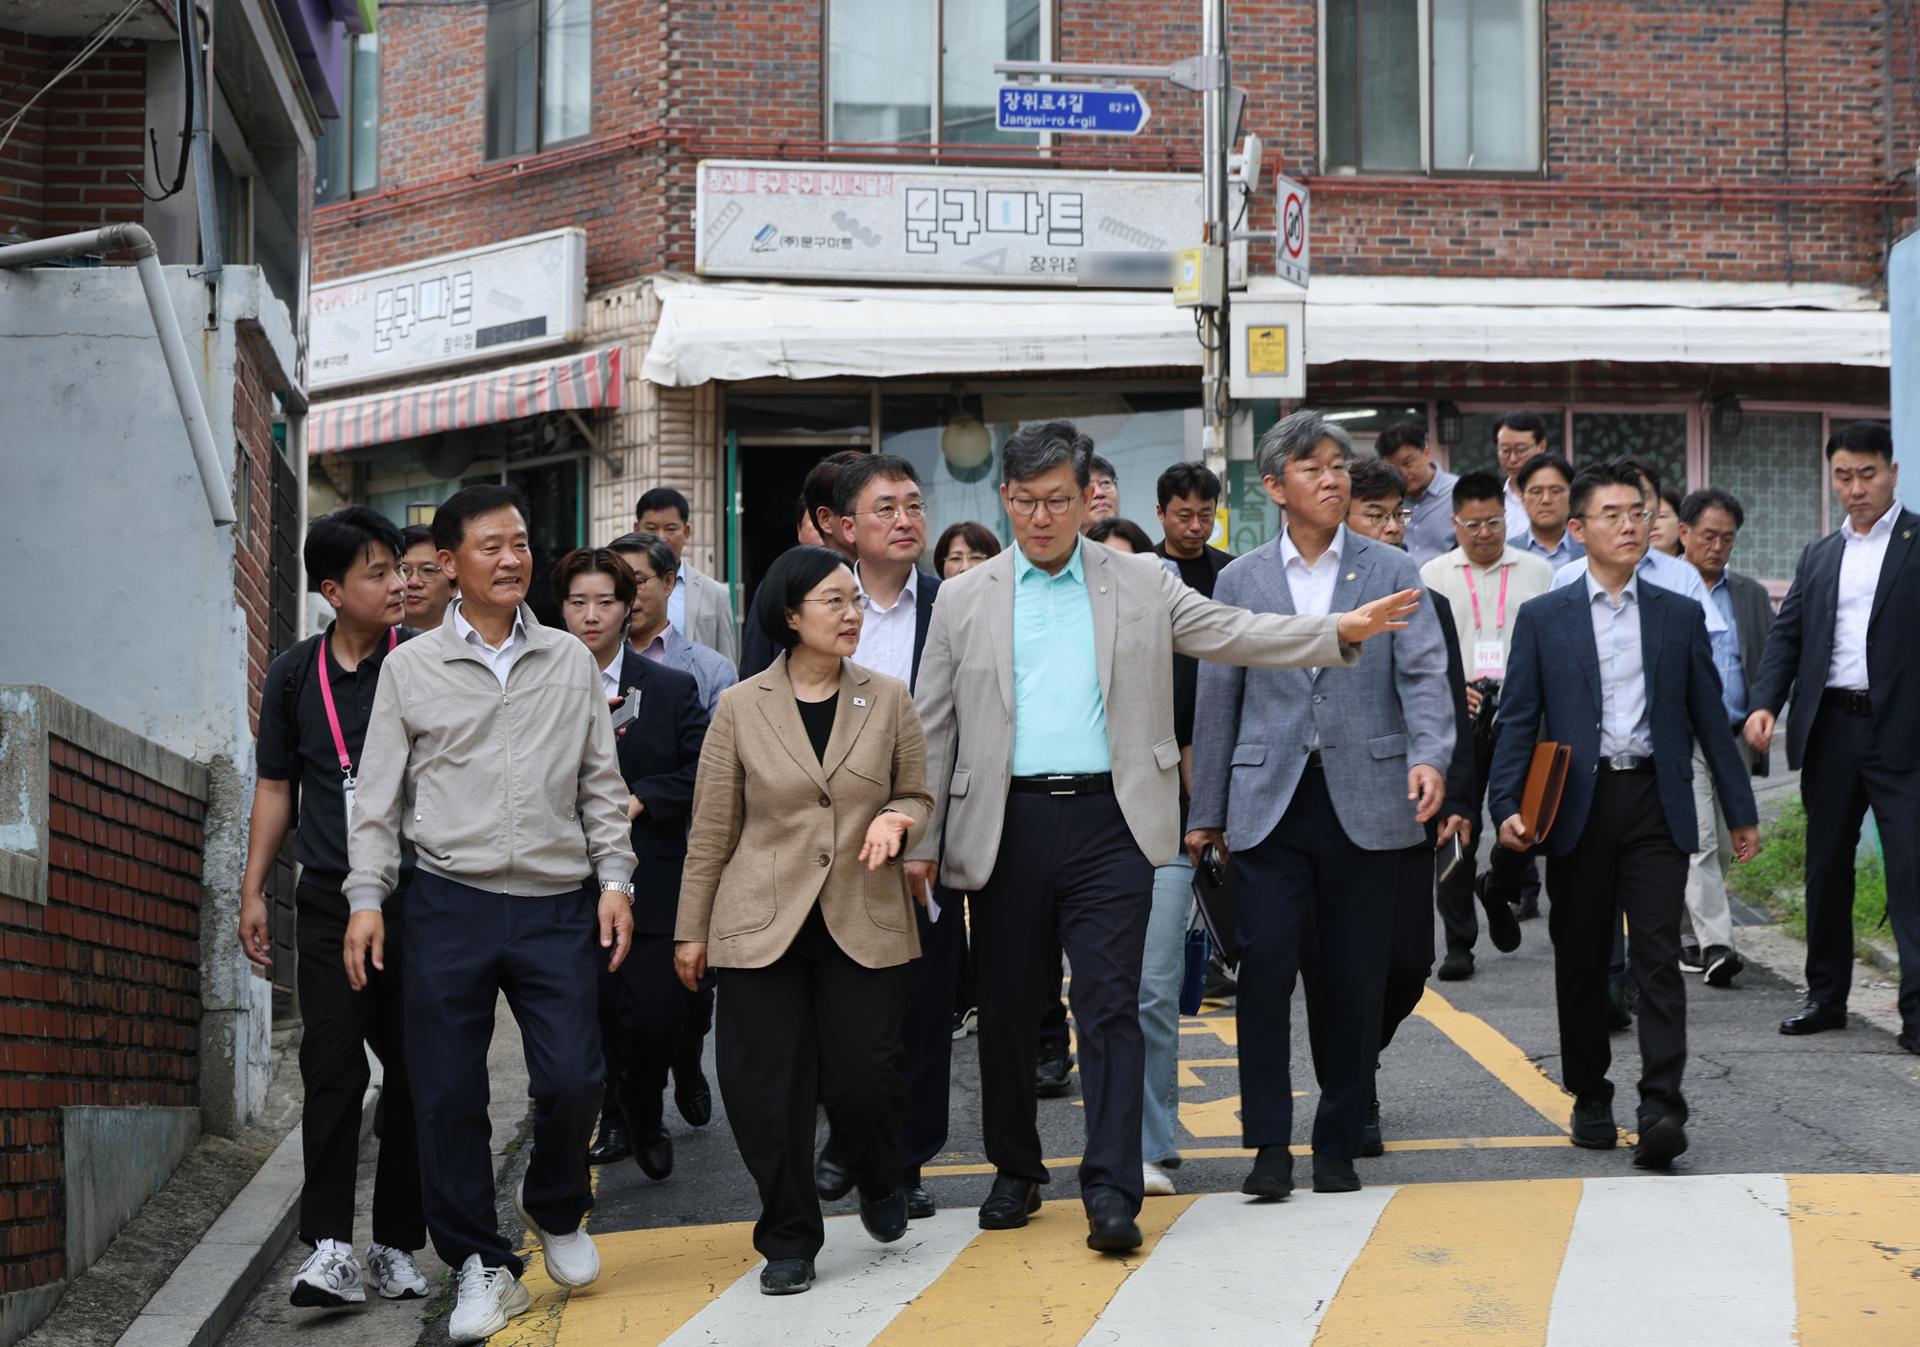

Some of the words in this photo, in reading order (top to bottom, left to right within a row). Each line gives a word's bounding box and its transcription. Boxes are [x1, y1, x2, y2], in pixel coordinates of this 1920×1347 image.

[1003, 91, 1083, 114] 장위로4길
[1003, 113, 1066, 128] Jangwi-ro
[1067, 115, 1097, 129] 4-gil
[755, 171, 781, 194] 문구
[906, 188, 1084, 254] 문구마트
[1288, 211, 1301, 241] 30
[373, 271, 473, 353] 문구마트
